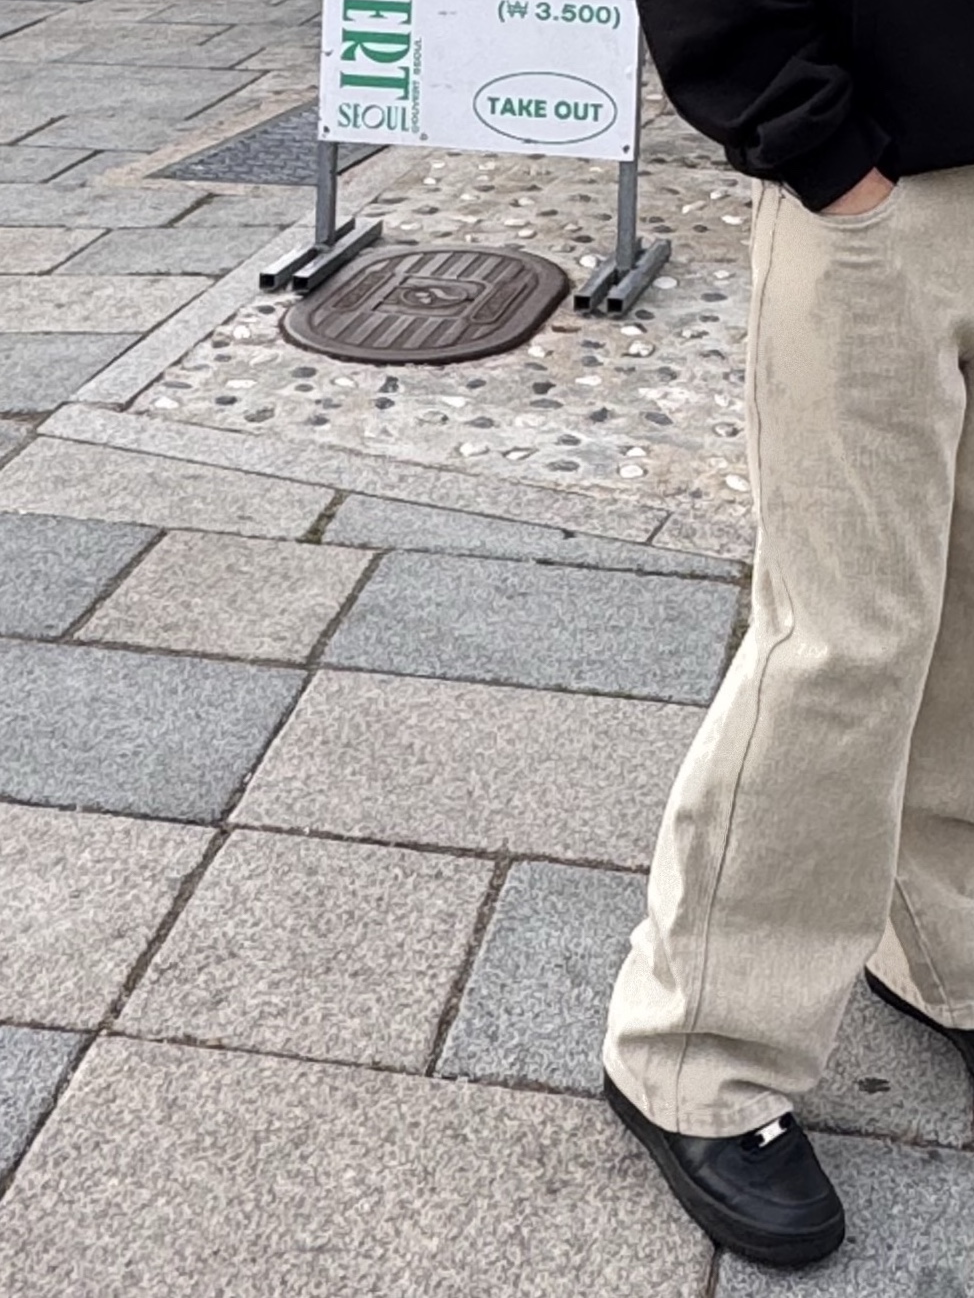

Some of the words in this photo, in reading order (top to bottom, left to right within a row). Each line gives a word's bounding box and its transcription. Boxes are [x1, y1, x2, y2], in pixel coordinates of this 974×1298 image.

[337, 102, 410, 132] SEOUL
[487, 96, 548, 118] TAKE
[554, 100, 604, 122] OUT
